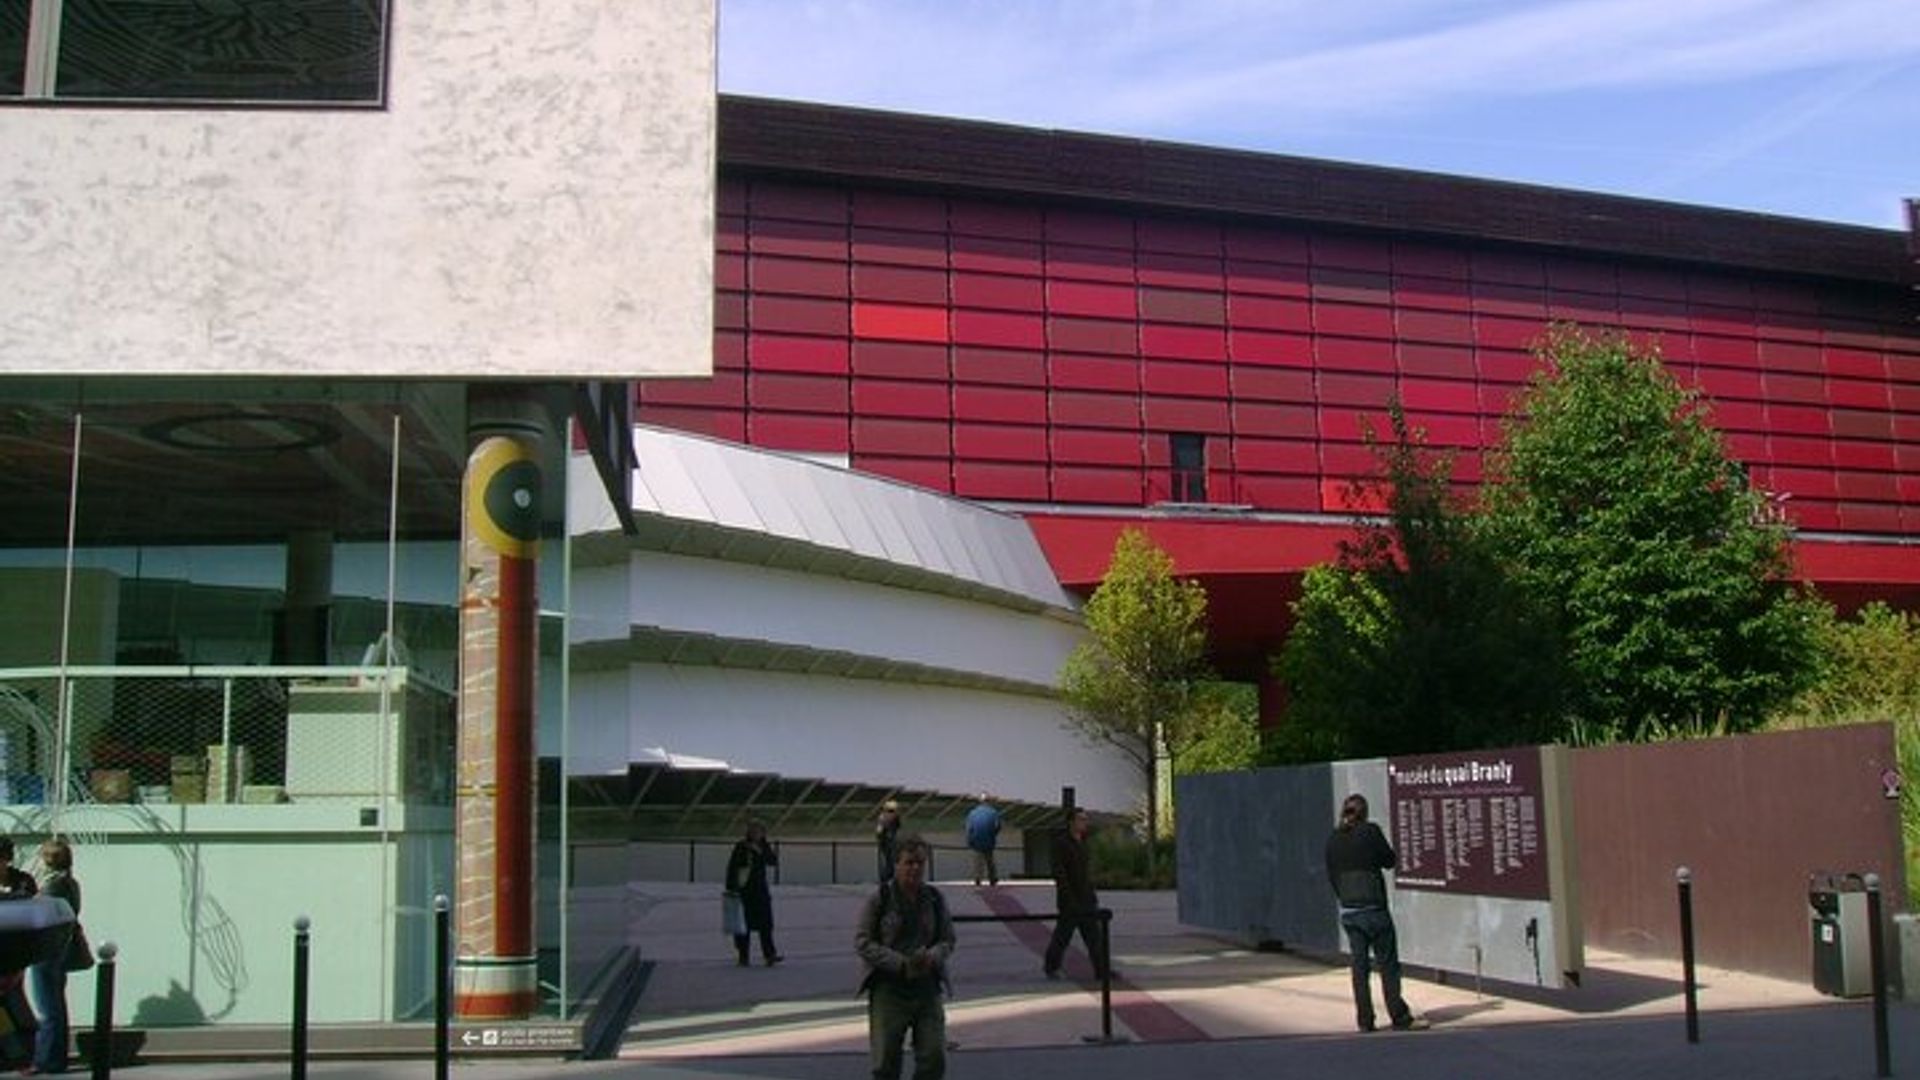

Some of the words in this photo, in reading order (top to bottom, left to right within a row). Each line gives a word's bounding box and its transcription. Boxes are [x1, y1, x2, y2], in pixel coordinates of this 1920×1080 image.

[1430, 764, 1444, 784] du
[1444, 762, 1470, 786] quai
[1471, 760, 1513, 784] Branly
